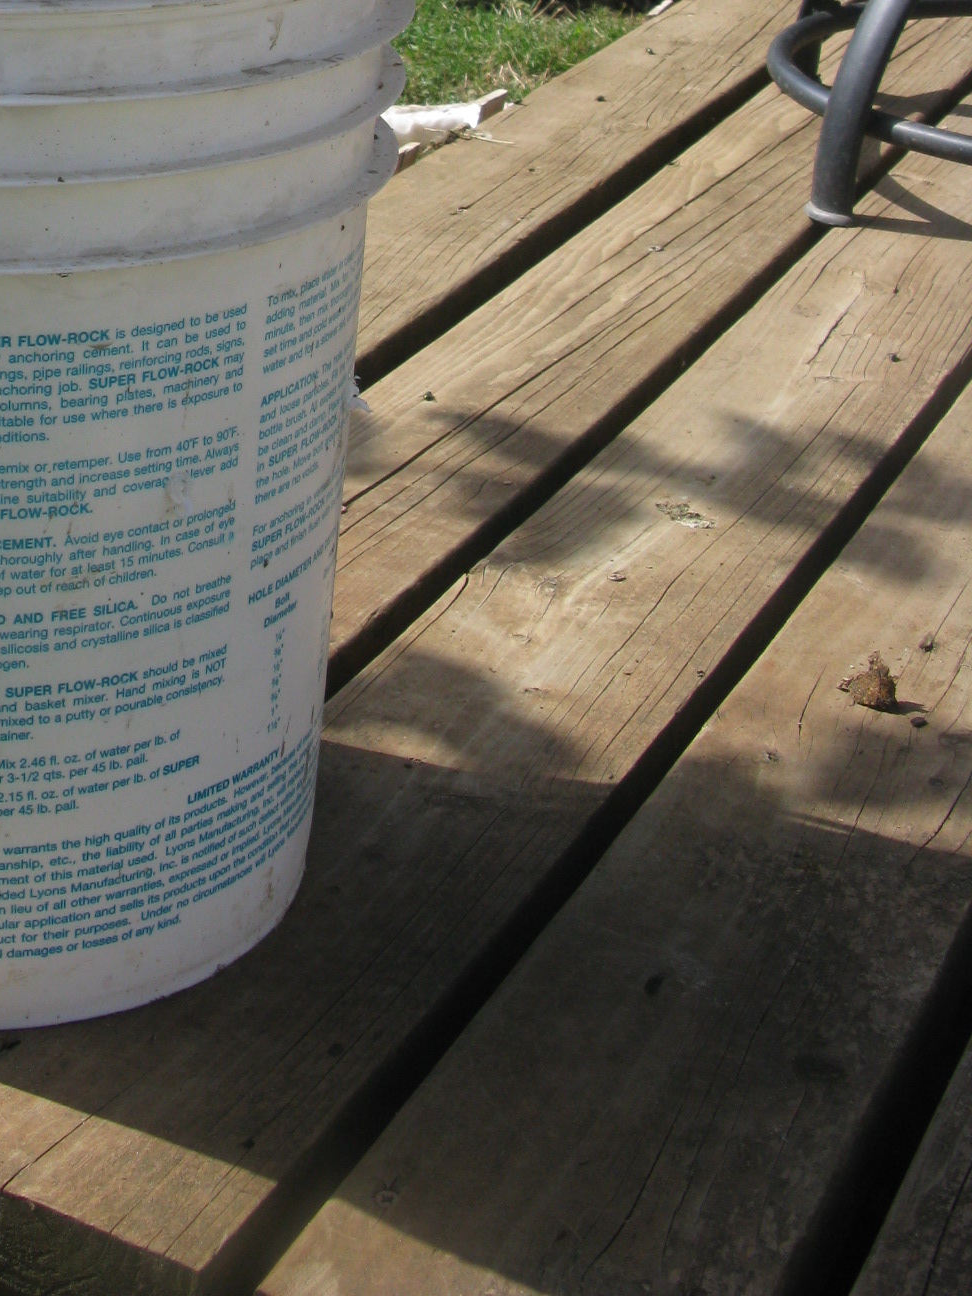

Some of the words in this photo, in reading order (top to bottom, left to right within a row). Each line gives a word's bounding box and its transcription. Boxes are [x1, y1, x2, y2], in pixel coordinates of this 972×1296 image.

[18, 330, 110, 346] FLOW-ROCK
[116, 328, 126, 339] is
[131, 318, 185, 337] designed
[190, 317, 201, 327] to
[206, 313, 219, 324] be
[222, 304, 248, 320] used
[33, 369, 61, 381] pipe
[67, 364, 114, 376] railings,
[120, 353, 182, 370] reinforcing
[187, 346, 212, 358] rods,
[217, 338, 245, 352] signs,
[59, 381, 82, 395] job.
[90, 374, 136, 390] SUPER
[143, 358, 219, 382] FLOW-ROCK
[225, 352, 245, 365] may
[34, 463, 49, 473] or
[53, 457, 112, 471] retemper.
[118, 452, 141, 464] Use
[146, 446, 172, 458] from
[203, 436, 213, 446] to
[65, 533, 99, 546] Avoid
[104, 531, 124, 543] eye
[128, 521, 169, 537] contact
[173, 519, 183, 528] or
[187, 500, 236, 526] prolonged
[14, 612, 44, 624] AND
[51, 608, 86, 621] FREE
[94, 600, 138, 616] SILICA.
[152, 594, 167, 606] Do
[174, 587, 190, 600] not
[196, 575, 232, 594] breathe
[16, 584, 36, 595] out
[40, 583, 52, 594] of
[56, 580, 90, 592] reach
[94, 576, 105, 588] of
[109, 569, 157, 585] children.
[248, 584, 273, 605] HOLE
[275, 556, 312, 590] DIAMETER
[274, 592, 290, 609] Bolt
[263, 600, 297, 629] Diameter
[6, 685, 52, 697] SUPER
[58, 671, 138, 693] FLOW-ROCK
[143, 661, 178, 679] should
[183, 658, 195, 669] be
[199, 644, 228, 663] mixed
[8, 772, 39, 784] 3-1/2
[44, 770, 65, 783] qts.
[70, 767, 89, 780] per
[92, 762, 106, 774] 45
[110, 760, 122, 771] lb.
[127, 754, 148, 769] pail.
[20, 757, 46, 769] 2.46
[50, 755, 60, 766] fl.
[64, 755, 81, 764] oz.
[85, 749, 97, 761] of
[100, 745, 131, 758] water
[134, 740, 152, 754] per
[155, 735, 167, 747] lb.
[170, 730, 181, 742] of
[187, 778, 230, 805] LIMITED
[232, 748, 280, 785] WARRANTY
[7, 946, 63, 959] damages
[66, 943, 79, 953] or
[82, 935, 119, 950] losses
[122, 929, 133, 941] of
[135, 926, 155, 938] any
[157, 915, 181, 931] kind.
